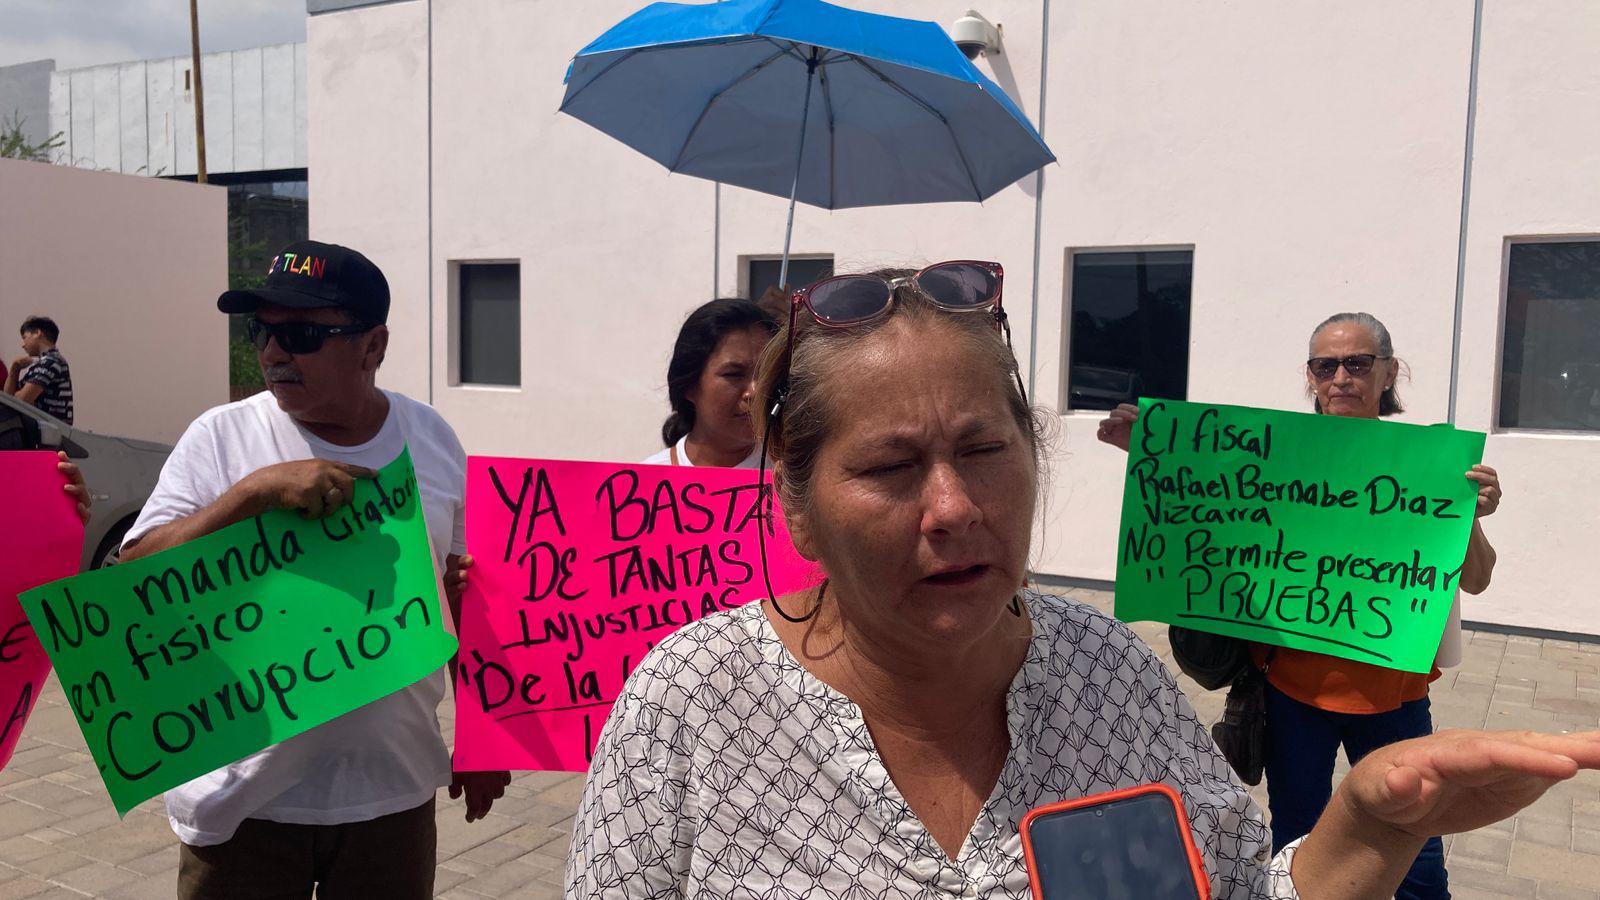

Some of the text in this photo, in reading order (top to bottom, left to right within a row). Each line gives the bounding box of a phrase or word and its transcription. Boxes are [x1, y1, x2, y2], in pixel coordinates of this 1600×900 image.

[1141, 402, 1272, 461] El fiscal
[1130, 458, 1229, 501] Rafael
[1235, 464, 1359, 509] Bernabe
[488, 466, 775, 563] YA BASTA
[1143, 503, 1272, 527] Vizcarra
[41, 587, 110, 653] No
[133, 515, 304, 616] manda
[517, 540, 753, 602] DE TANTAS
[1185, 529, 1308, 573] Permite
[1316, 550, 1464, 592] presentar
[71, 670, 116, 723] en
[562, 661, 603, 704] la
